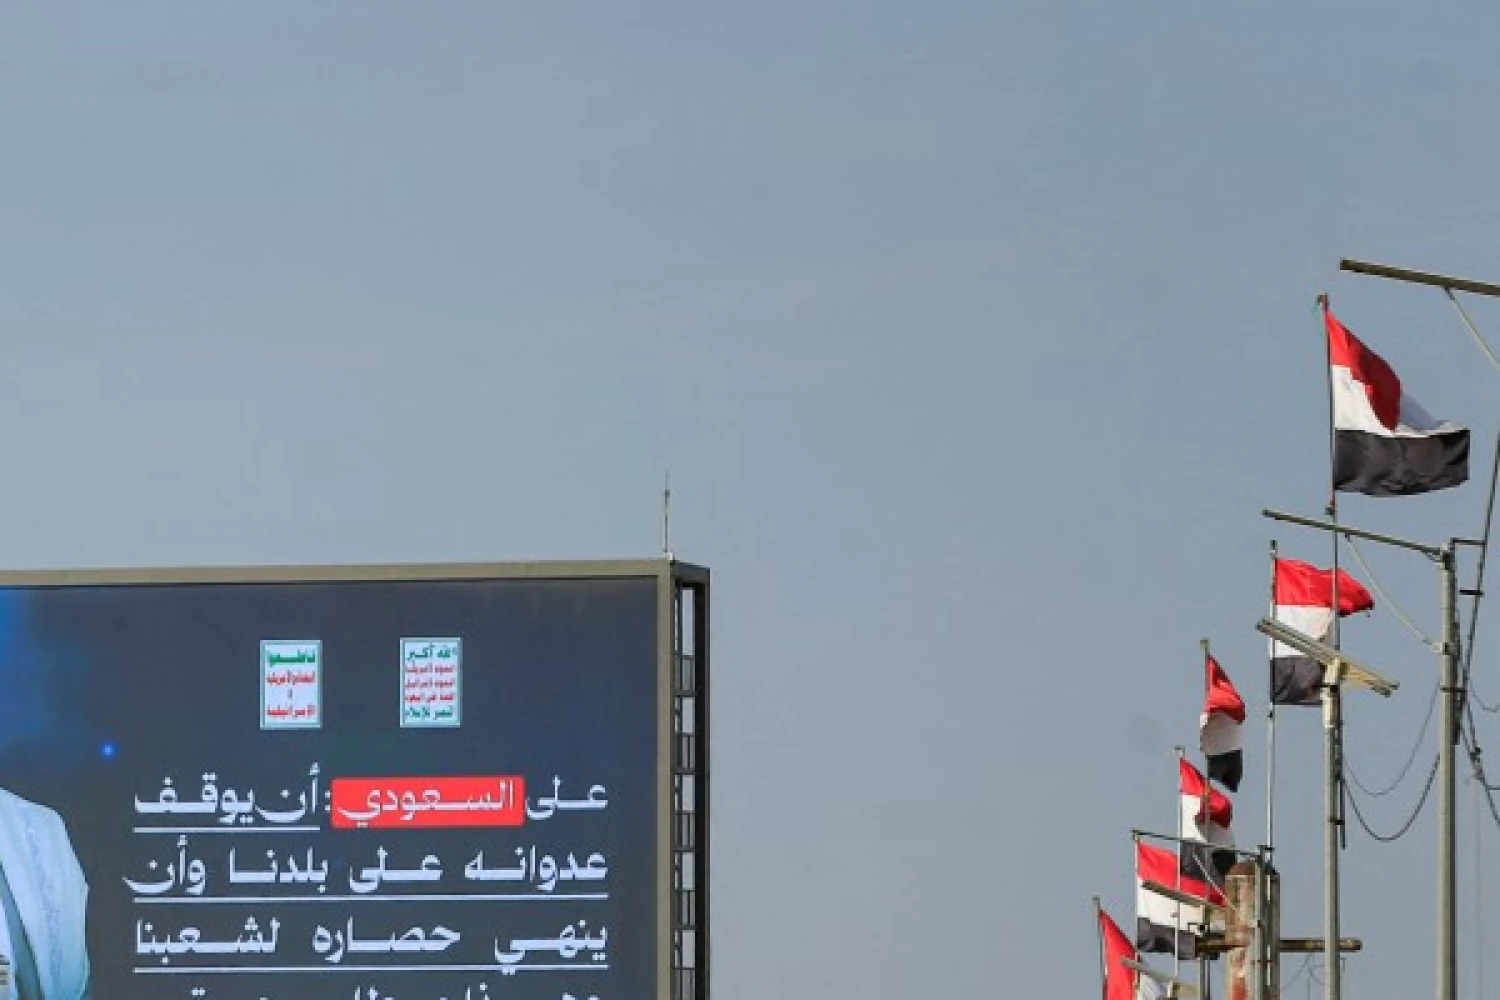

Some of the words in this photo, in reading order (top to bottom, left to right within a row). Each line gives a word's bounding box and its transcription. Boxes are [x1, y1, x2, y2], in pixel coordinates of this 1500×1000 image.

[134, 771, 255, 825] يوقف
[254, 762, 321, 823] أن
[525, 775, 608, 821] على
[122, 834, 206, 895] وأن
[229, 846, 329, 893] بلدنا
[349, 845, 443, 893] على
[464, 844, 608, 892] عدوانه
[137, 915, 281, 965] لشعبنا
[312, 916, 461, 963] حصاره
[495, 919, 608, 975] ينهي
